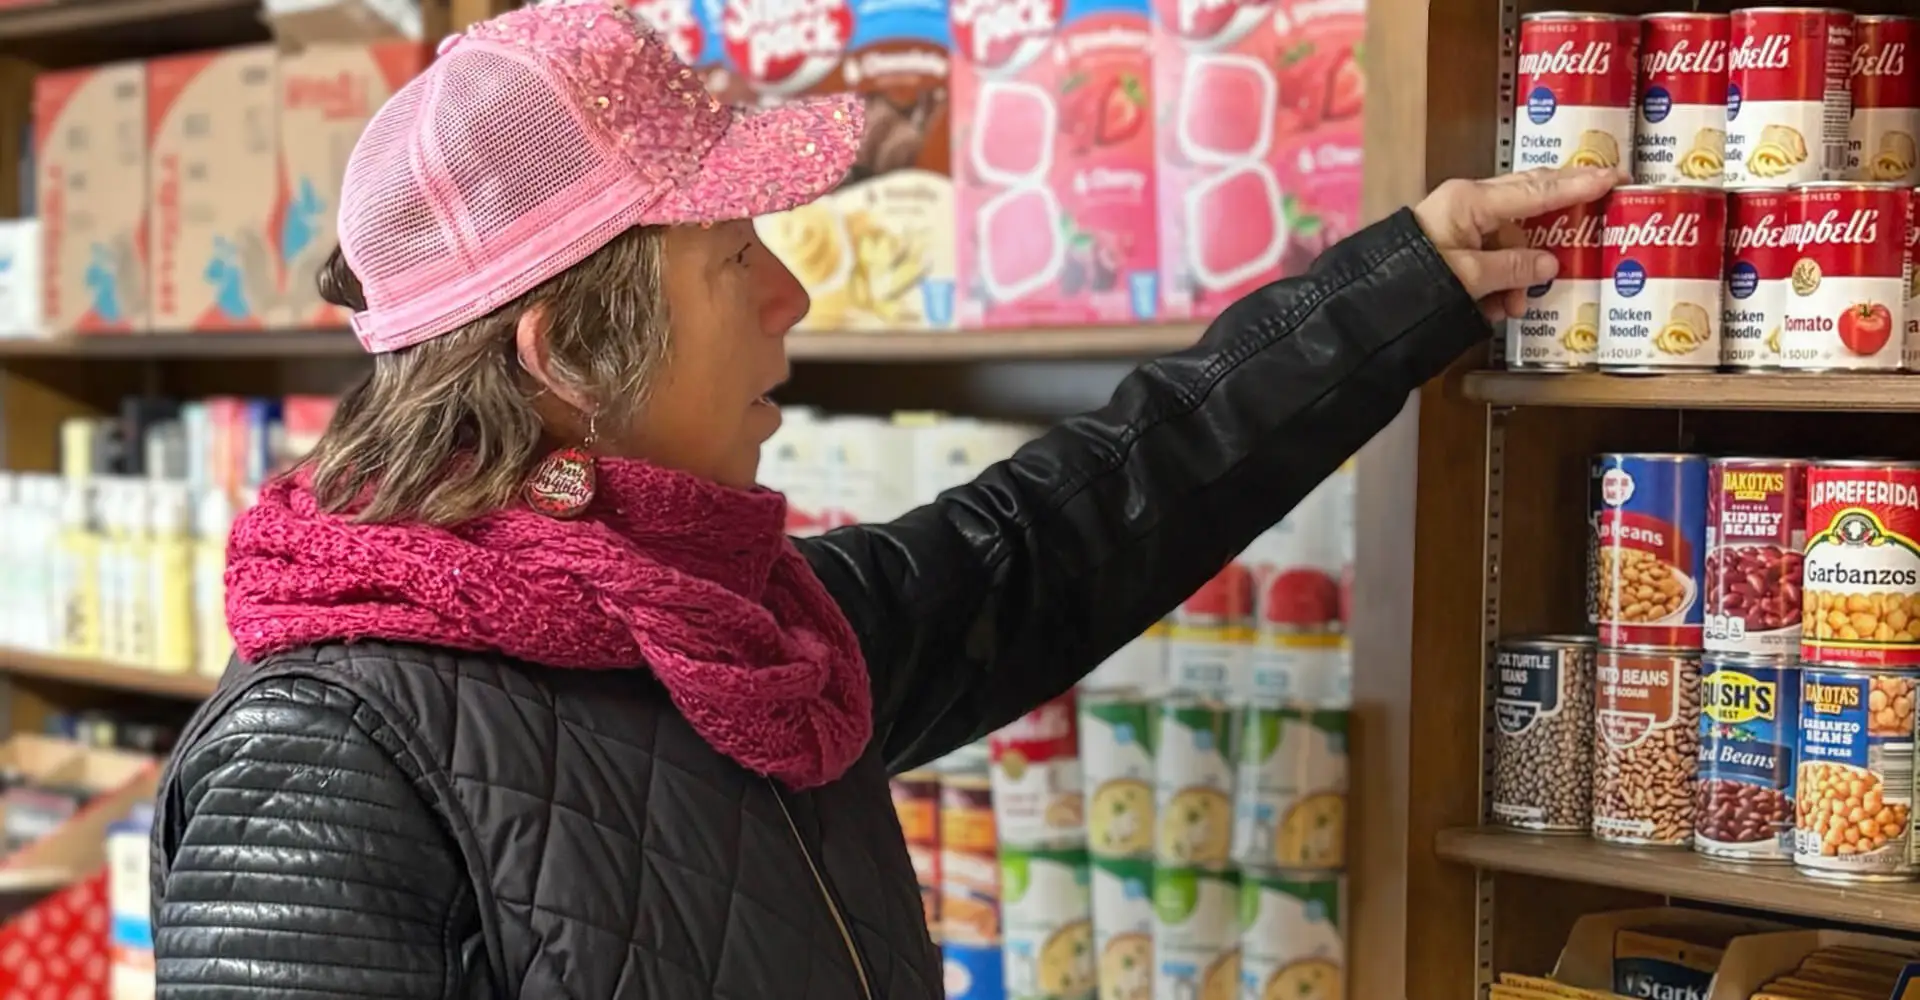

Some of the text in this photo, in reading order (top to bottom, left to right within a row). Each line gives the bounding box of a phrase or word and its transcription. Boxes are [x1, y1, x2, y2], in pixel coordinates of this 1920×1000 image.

[1521, 135, 1562, 148] Chicken
[1521, 151, 1559, 164] Noodle
[1608, 307, 1652, 321] Chicken
[1609, 324, 1649, 338] Noodle
[1784, 314, 1834, 332] Tomato
[1825, 480, 1919, 510] PREFERIDA
[1722, 511, 1783, 525] KIDNEY
[1724, 523, 1777, 536] BEANS
[1808, 559, 1917, 585] Garbanzos
[1622, 668, 1669, 687] BEANS
[1702, 681, 1772, 714] BUSH'S
[1720, 745, 1777, 770] Beans
